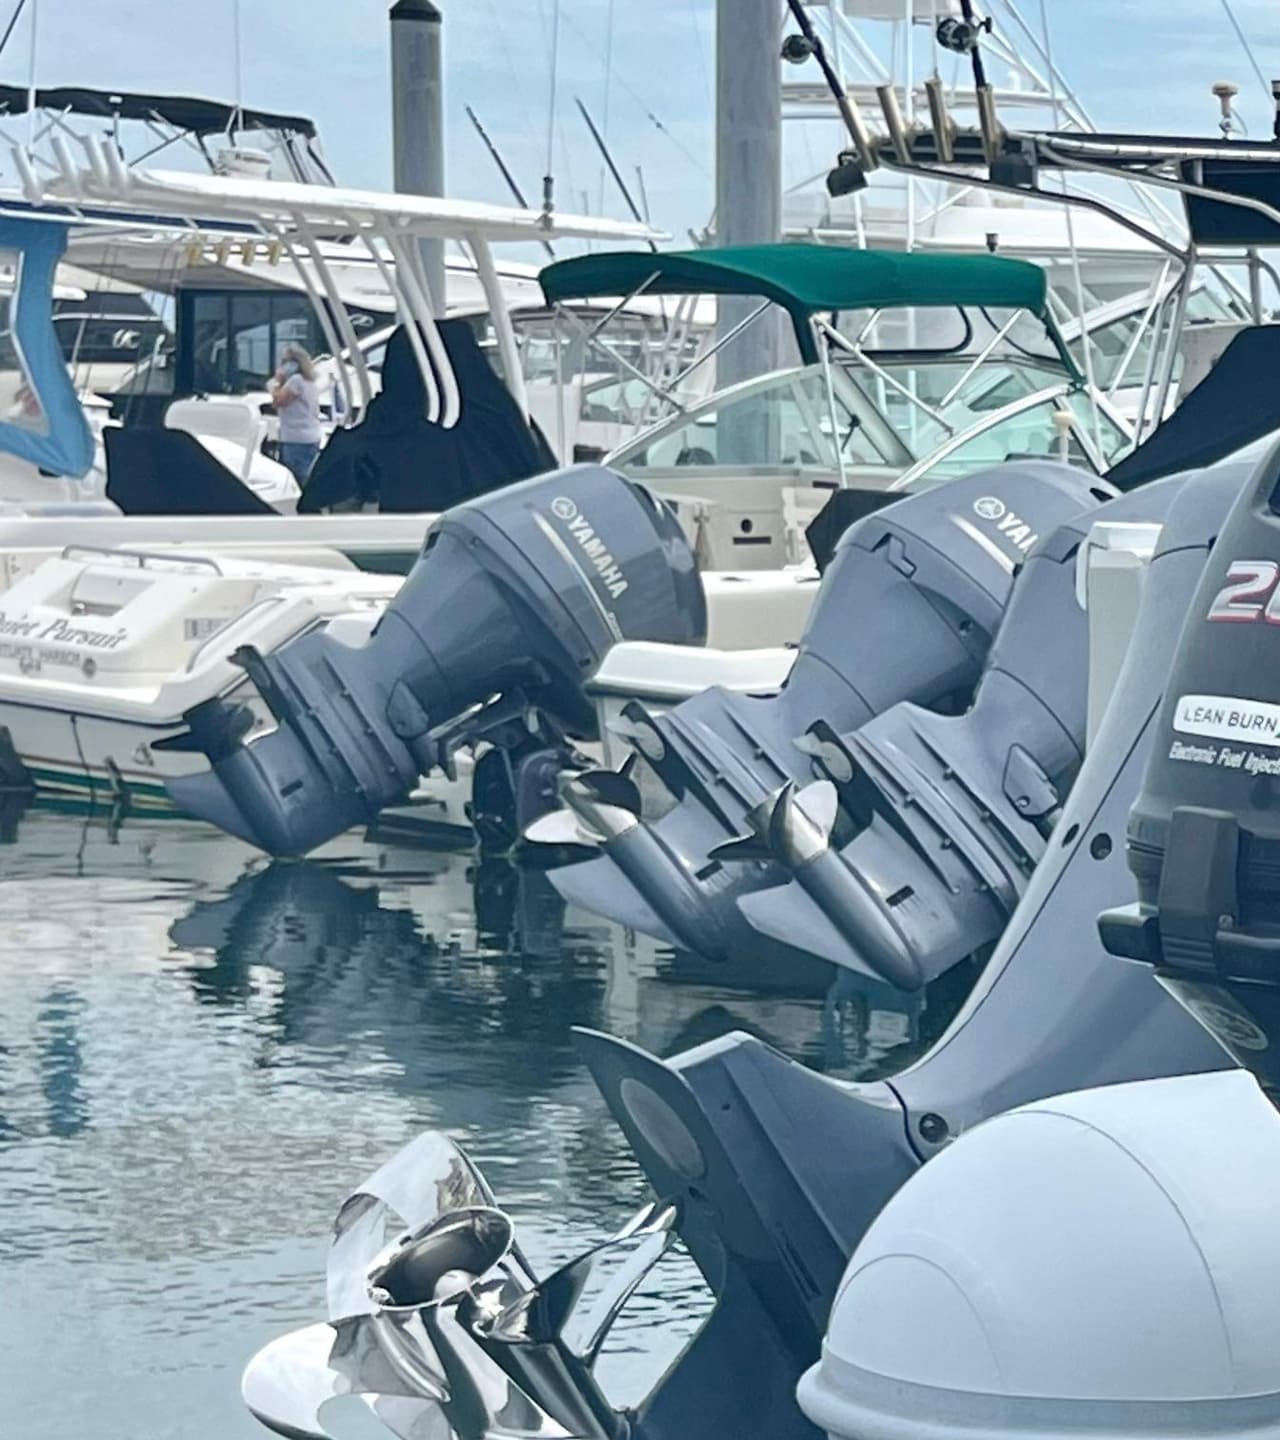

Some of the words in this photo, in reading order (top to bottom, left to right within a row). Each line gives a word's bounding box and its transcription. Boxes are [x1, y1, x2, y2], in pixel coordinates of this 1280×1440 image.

[568, 514, 629, 600] YAMAHA
[36, 617, 128, 650] Pursuit
[1183, 708, 1226, 725] LEAN
[1227, 711, 1278, 732] BURN
[1169, 741, 1217, 765] Electronic
[1217, 747, 1247, 769] Fuel
